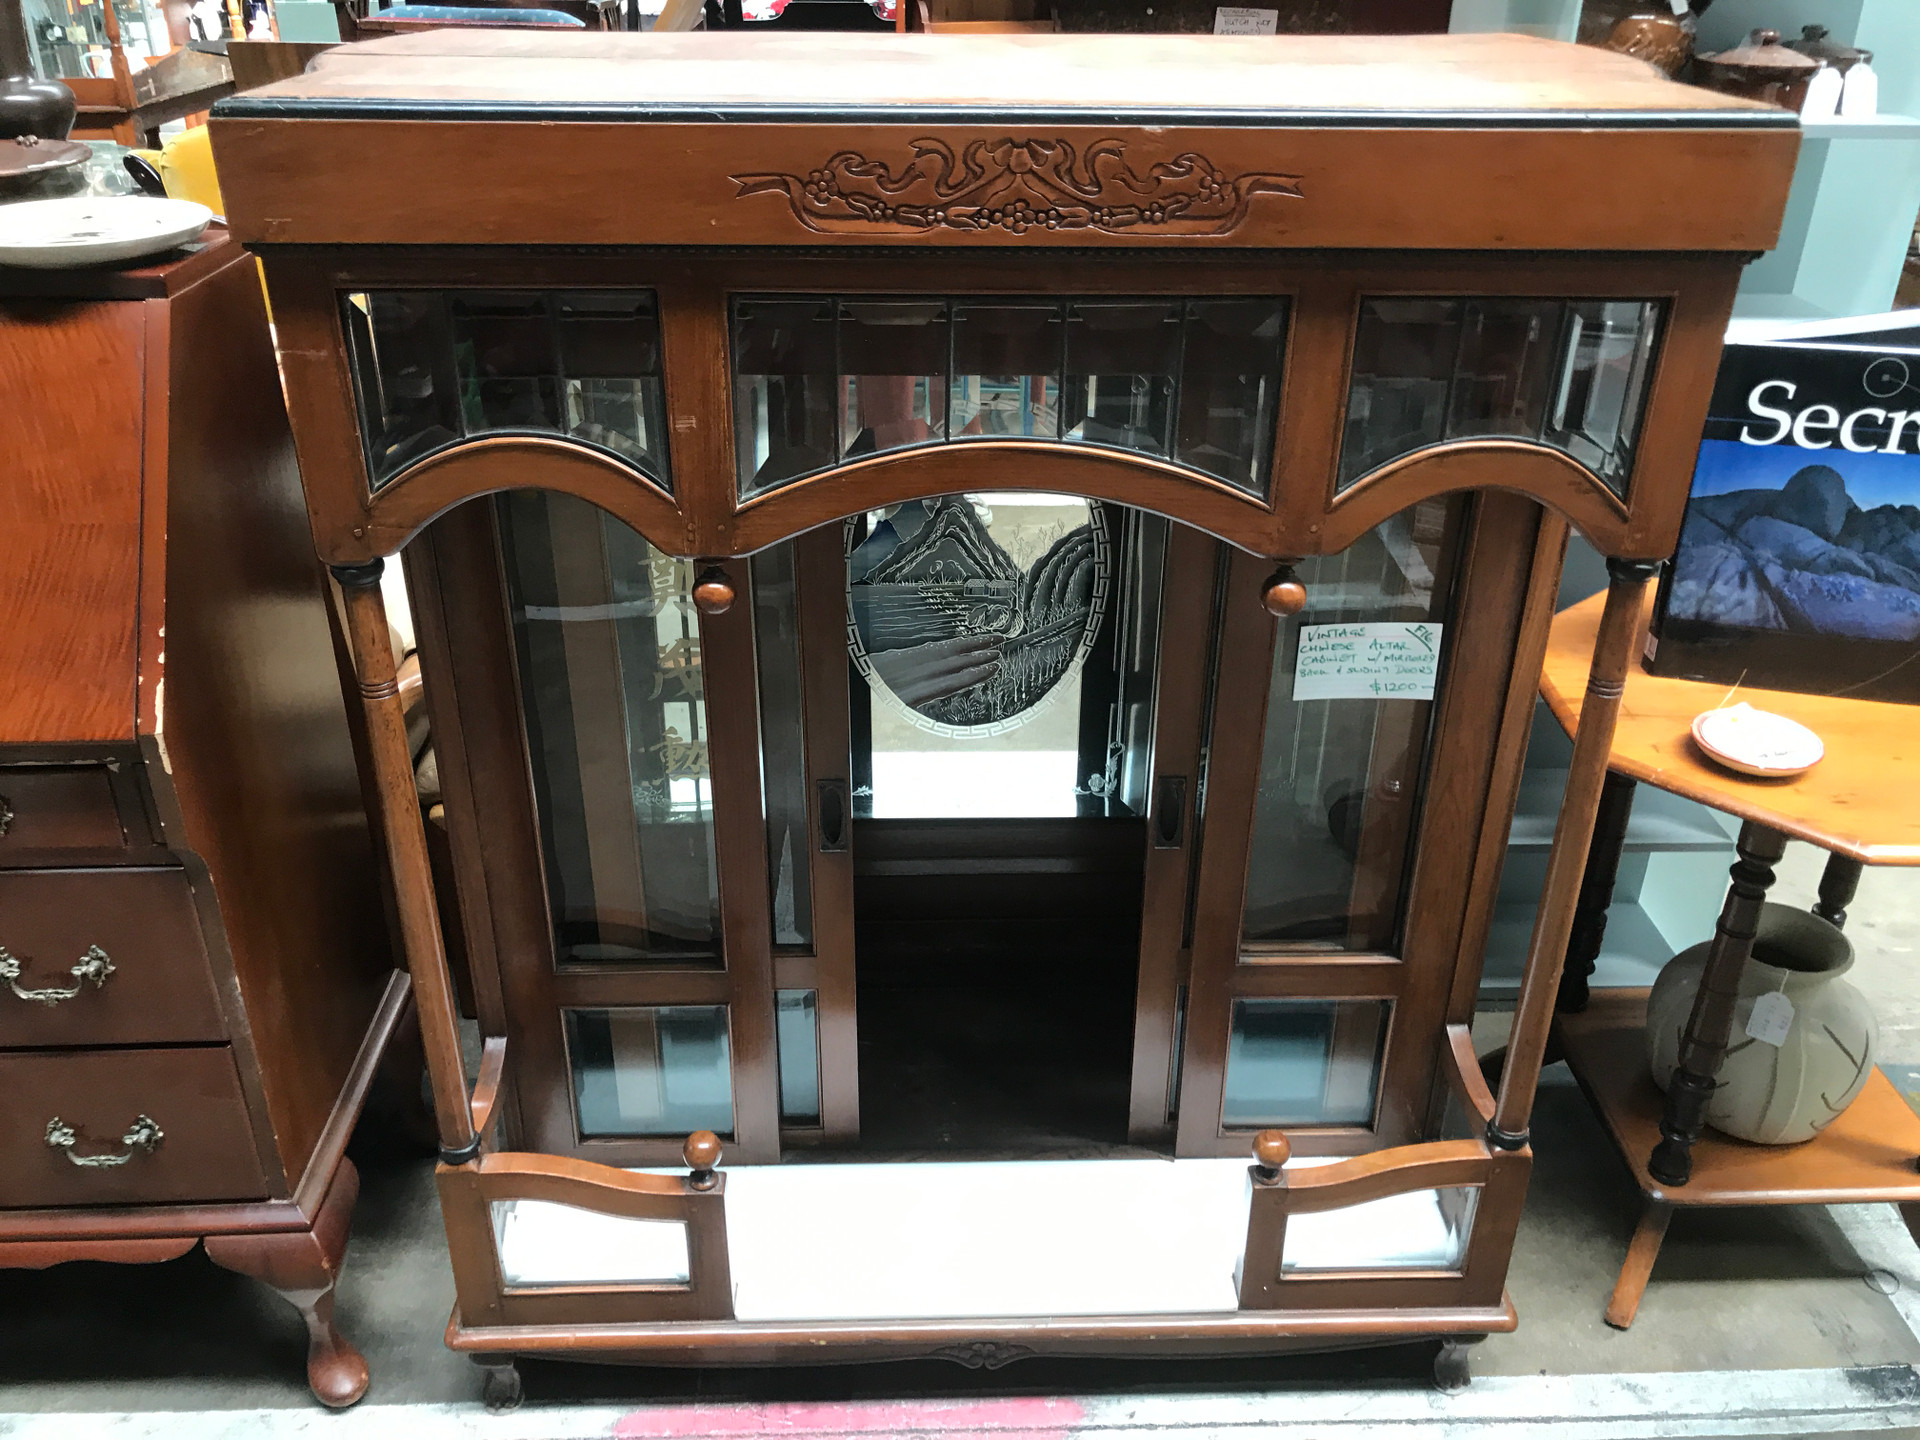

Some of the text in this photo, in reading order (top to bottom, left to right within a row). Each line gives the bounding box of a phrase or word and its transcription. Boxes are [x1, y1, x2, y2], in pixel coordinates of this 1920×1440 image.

[1739, 380, 1920, 455] Secr
[1308, 626, 1365, 642] VINTAGE
[1300, 638, 1411, 654] CHINESE ALTAR
[1301, 654, 1357, 666] CABINET
[1395, 665, 1433, 675] DOORS
